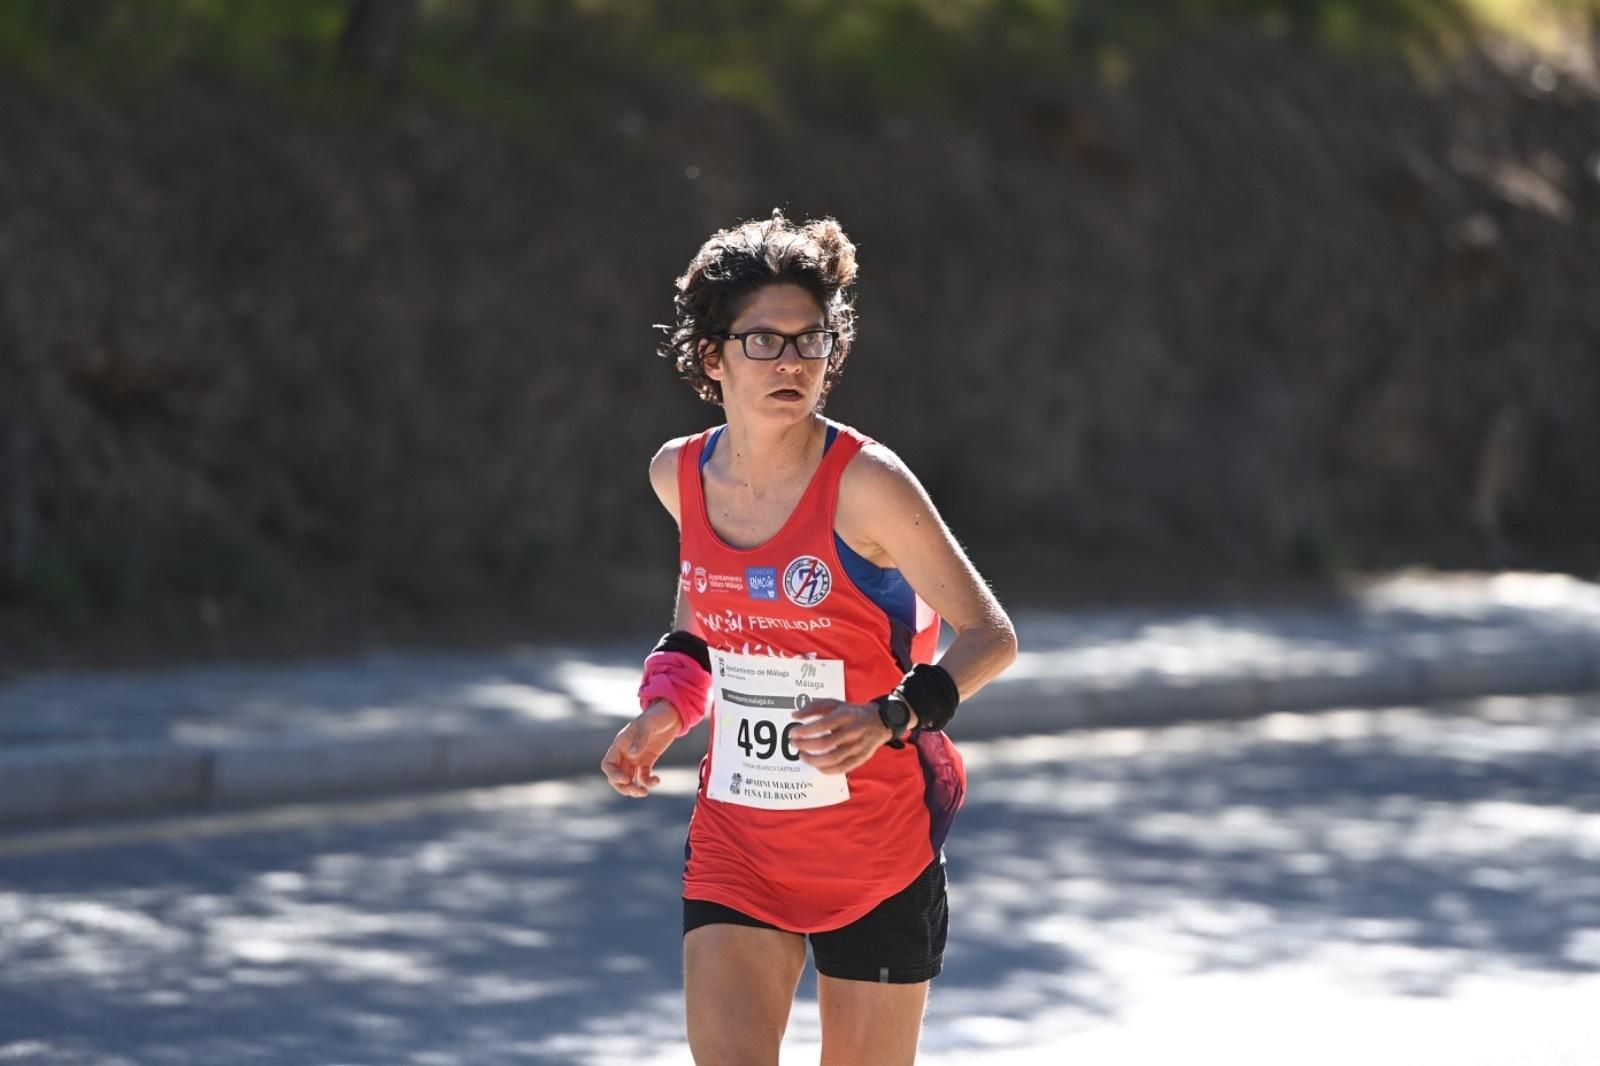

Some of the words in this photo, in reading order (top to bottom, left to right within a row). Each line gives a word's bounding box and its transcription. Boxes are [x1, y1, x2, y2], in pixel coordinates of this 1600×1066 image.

[748, 616, 832, 631] FERTILIDAD
[766, 669, 790, 678] Málaga
[795, 679, 825, 689] Málaga
[737, 718, 804, 762] 496
[763, 791, 772, 799] EL
